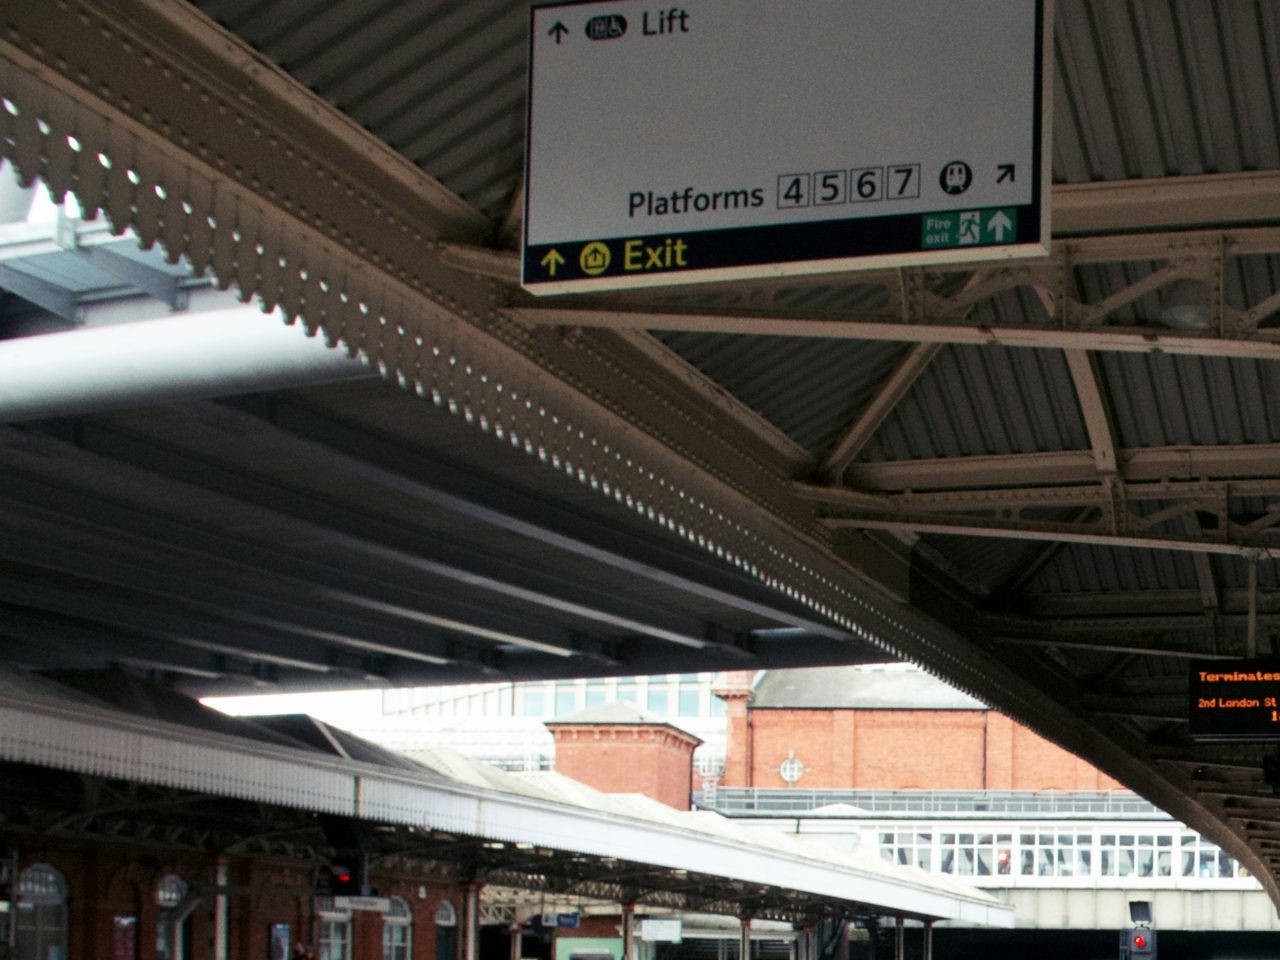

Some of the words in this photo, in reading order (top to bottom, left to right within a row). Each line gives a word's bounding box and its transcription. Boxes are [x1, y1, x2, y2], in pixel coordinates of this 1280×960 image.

[642, 7, 690, 36] Lift
[628, 186, 764, 218] Platforms
[783, 177, 803, 204] 4
[820, 174, 839, 202] 5
[856, 171, 877, 199] 6
[893, 168, 914, 197] 7
[926, 218, 951, 230] Fire
[926, 231, 949, 244] exit
[623, 239, 688, 270] Exit
[1199, 671, 1280, 682] Terminates
[1198, 698, 1216, 708] 2nd
[1218, 697, 1260, 708] London
[1264, 697, 1277, 708] St
